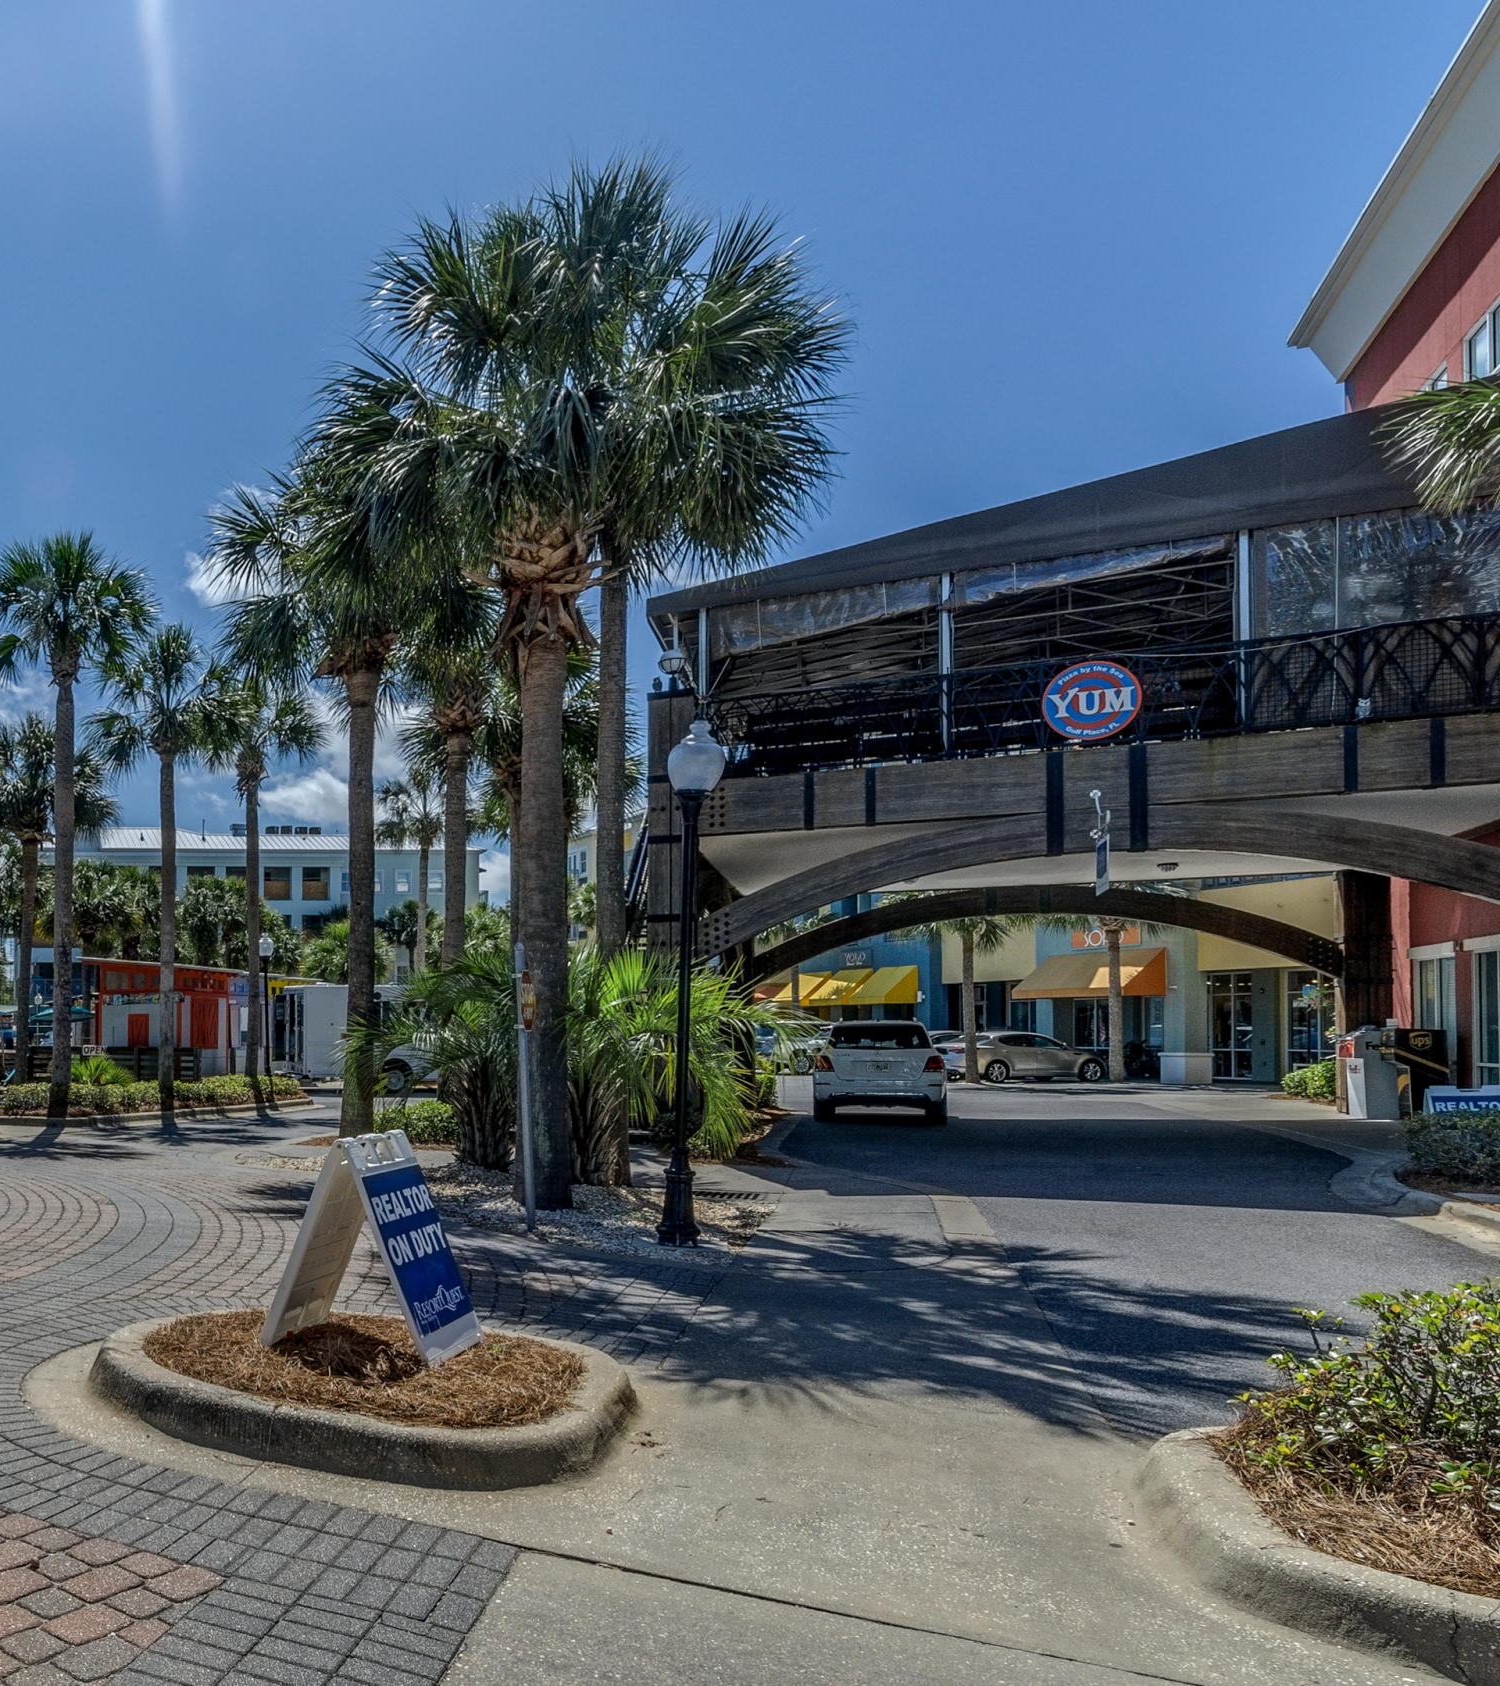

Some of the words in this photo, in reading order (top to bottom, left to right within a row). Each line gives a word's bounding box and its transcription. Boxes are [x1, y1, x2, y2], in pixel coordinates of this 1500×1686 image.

[1057, 671, 1079, 685] Pizza
[1109, 667, 1124, 679] Sea
[1047, 686, 1135, 718] YUM
[1065, 725, 1082, 735] Gulf
[1083, 728, 1109, 736] Place,
[1109, 721, 1120, 730] FL
[83, 1045, 107, 1055] OPEN
[1411, 1036, 1431, 1049] ups
[371, 1184, 435, 1225] REALTOR
[388, 1234, 415, 1266] ON
[410, 1222, 447, 1258] DUTY
